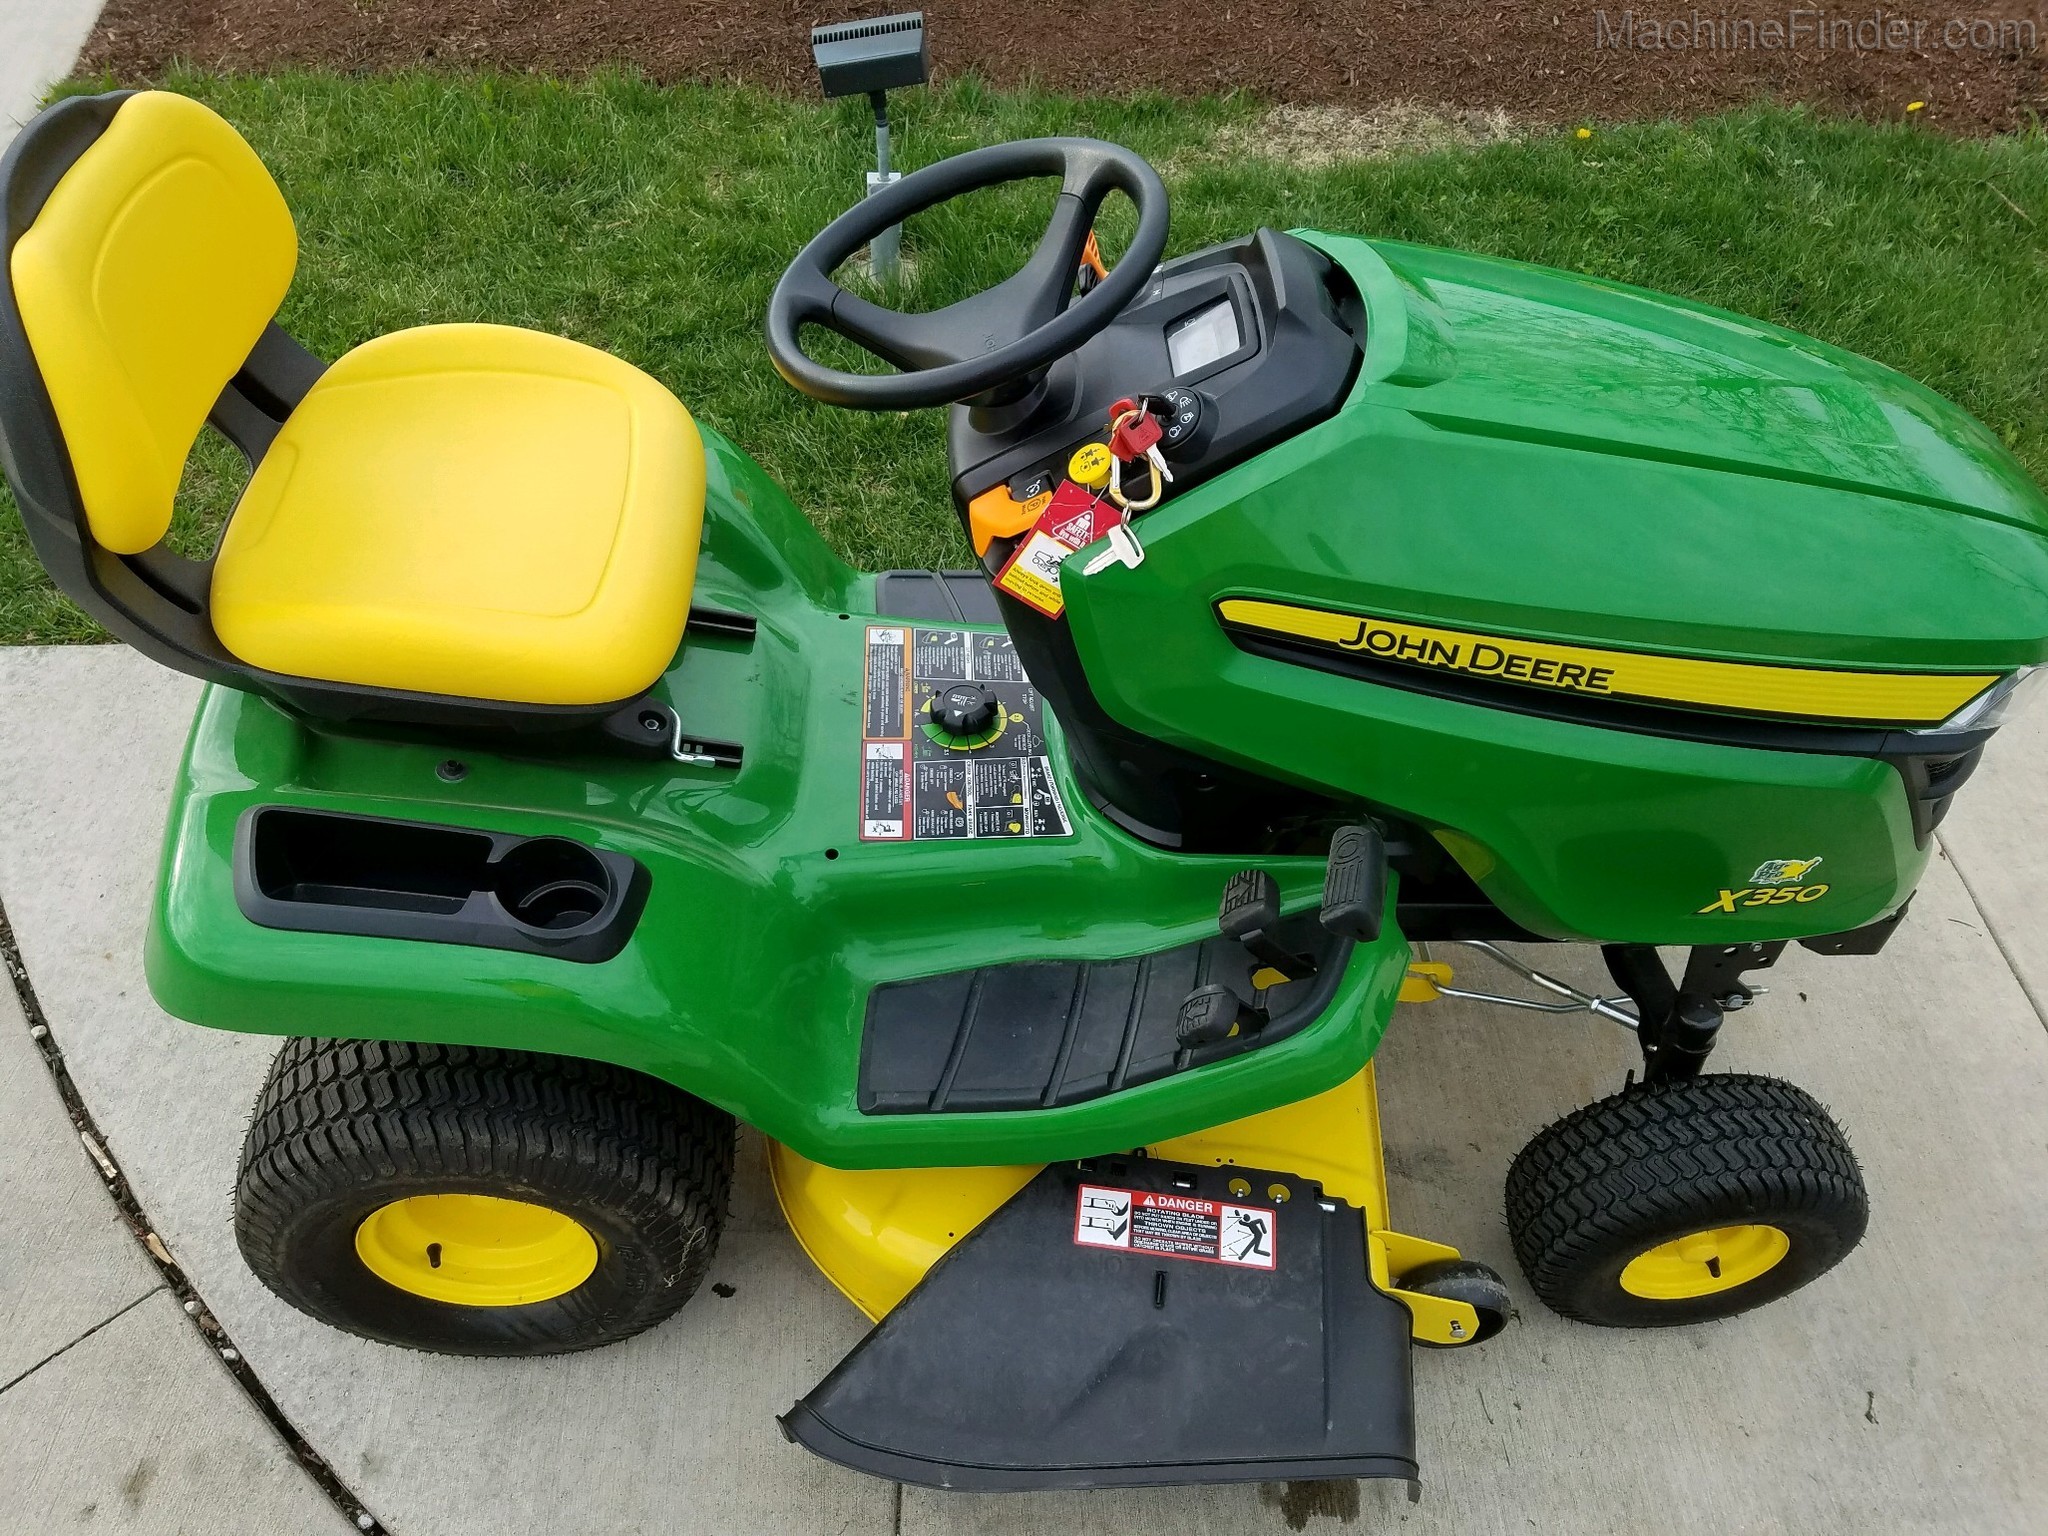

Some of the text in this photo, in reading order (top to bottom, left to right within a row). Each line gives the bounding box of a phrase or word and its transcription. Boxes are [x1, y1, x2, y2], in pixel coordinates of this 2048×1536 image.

[1339, 621, 1615, 691] JOHN DEERE
[1696, 884, 1829, 914] X350
[1146, 1207, 1205, 1220] ROTATING BLADE
[1158, 1196, 1213, 1214] DANGER
[1144, 1220, 1206, 1234] THROWN OBJECTS
